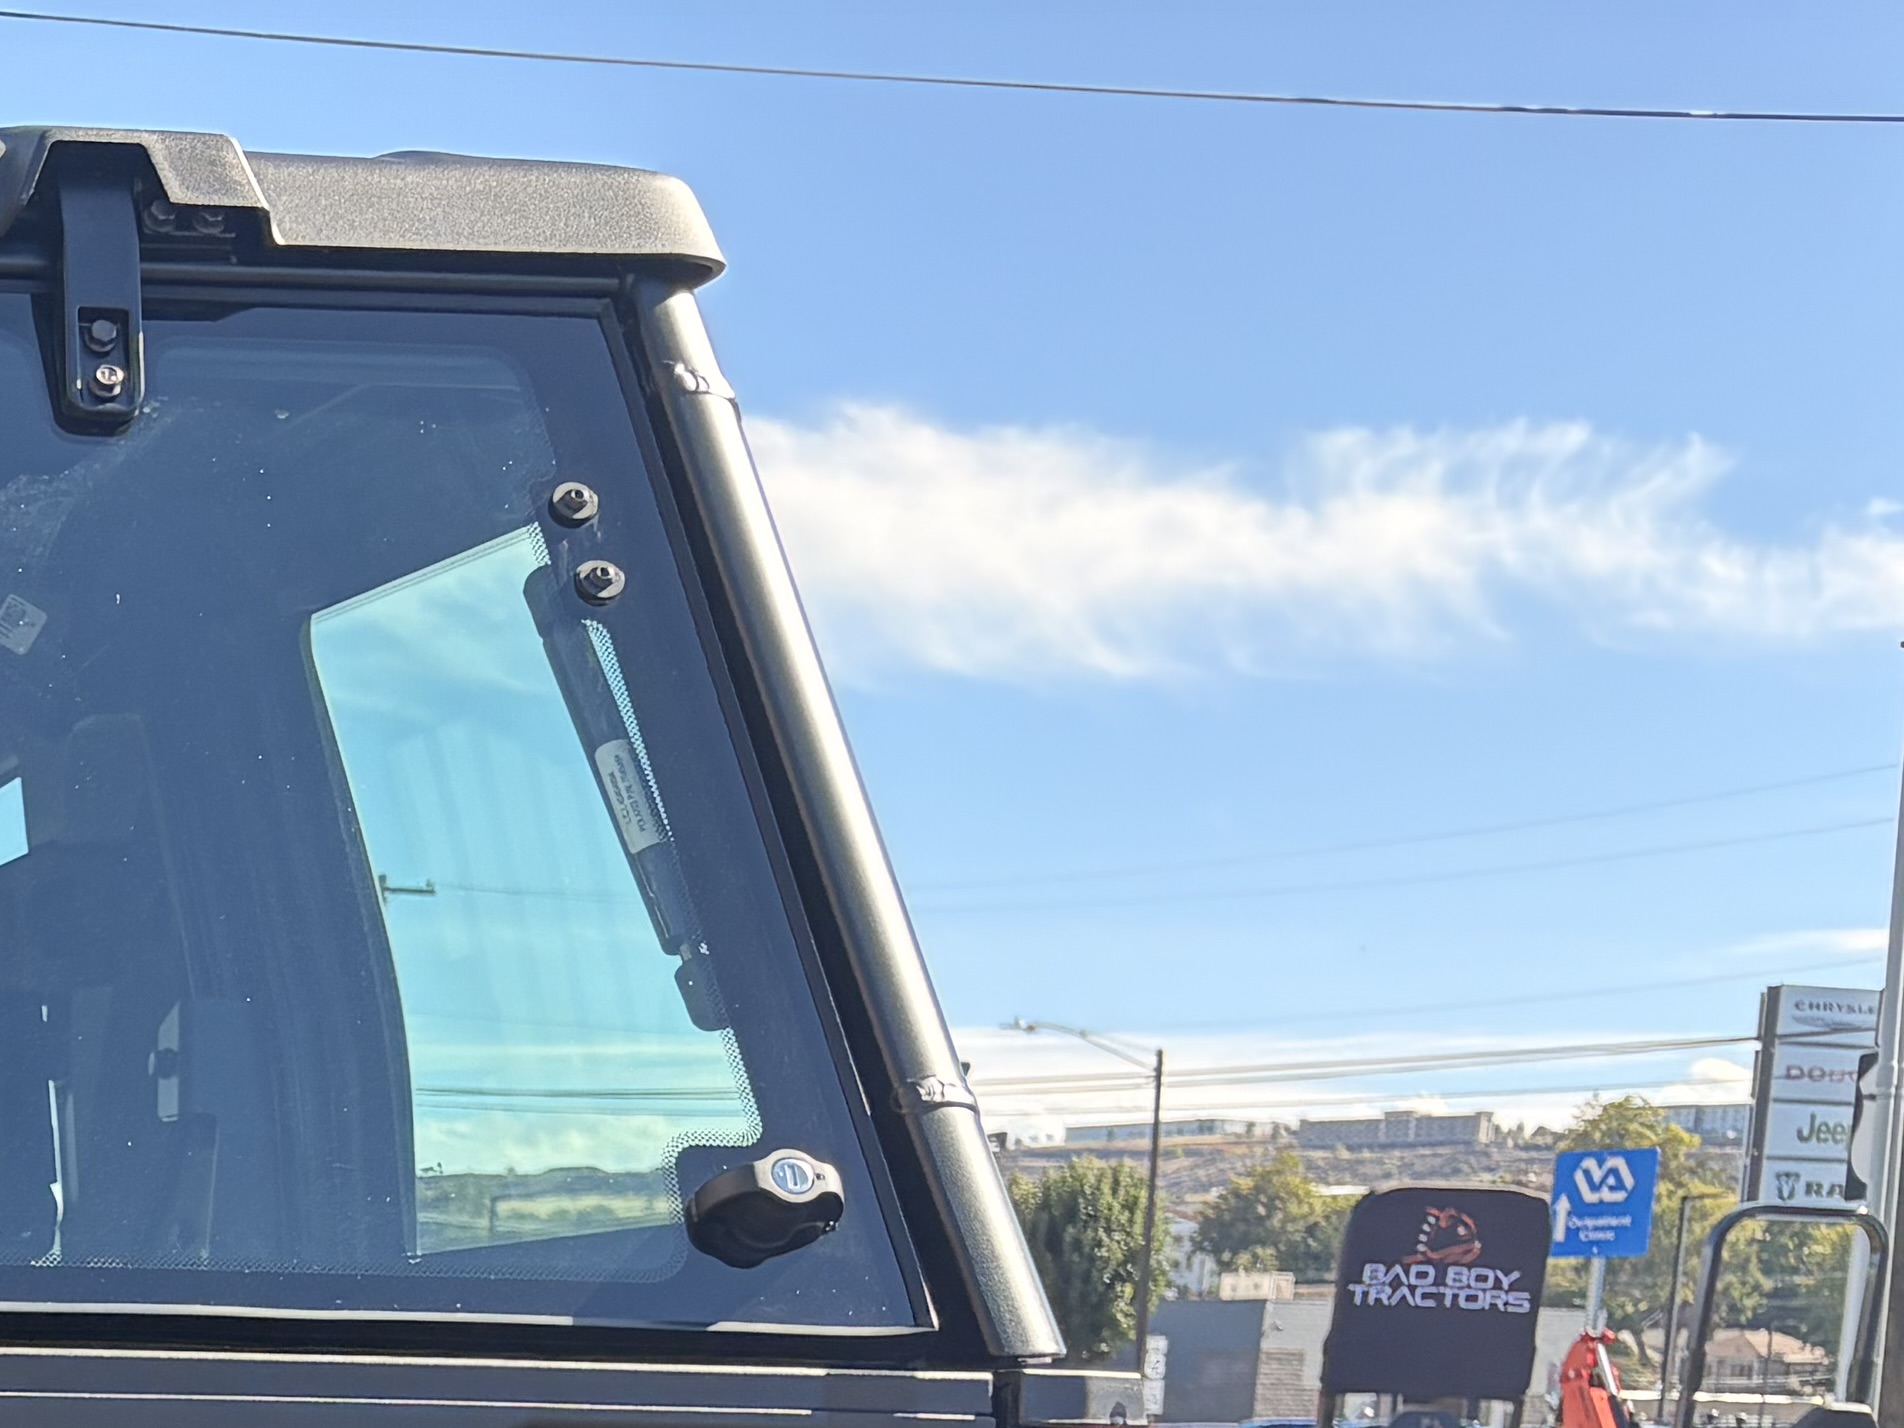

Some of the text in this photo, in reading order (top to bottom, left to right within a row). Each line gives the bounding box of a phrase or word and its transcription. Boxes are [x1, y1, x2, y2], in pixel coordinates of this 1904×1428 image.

[1794, 999, 1876, 1016] CHRYSLE
[1784, 1064, 1858, 1083] DOD
[1796, 1111, 1849, 1145] Jee
[1804, 1180, 1845, 1199] RA
[1362, 1263, 1521, 1290] BAD BOY
[1347, 1283, 1531, 1313] TRACTORS
